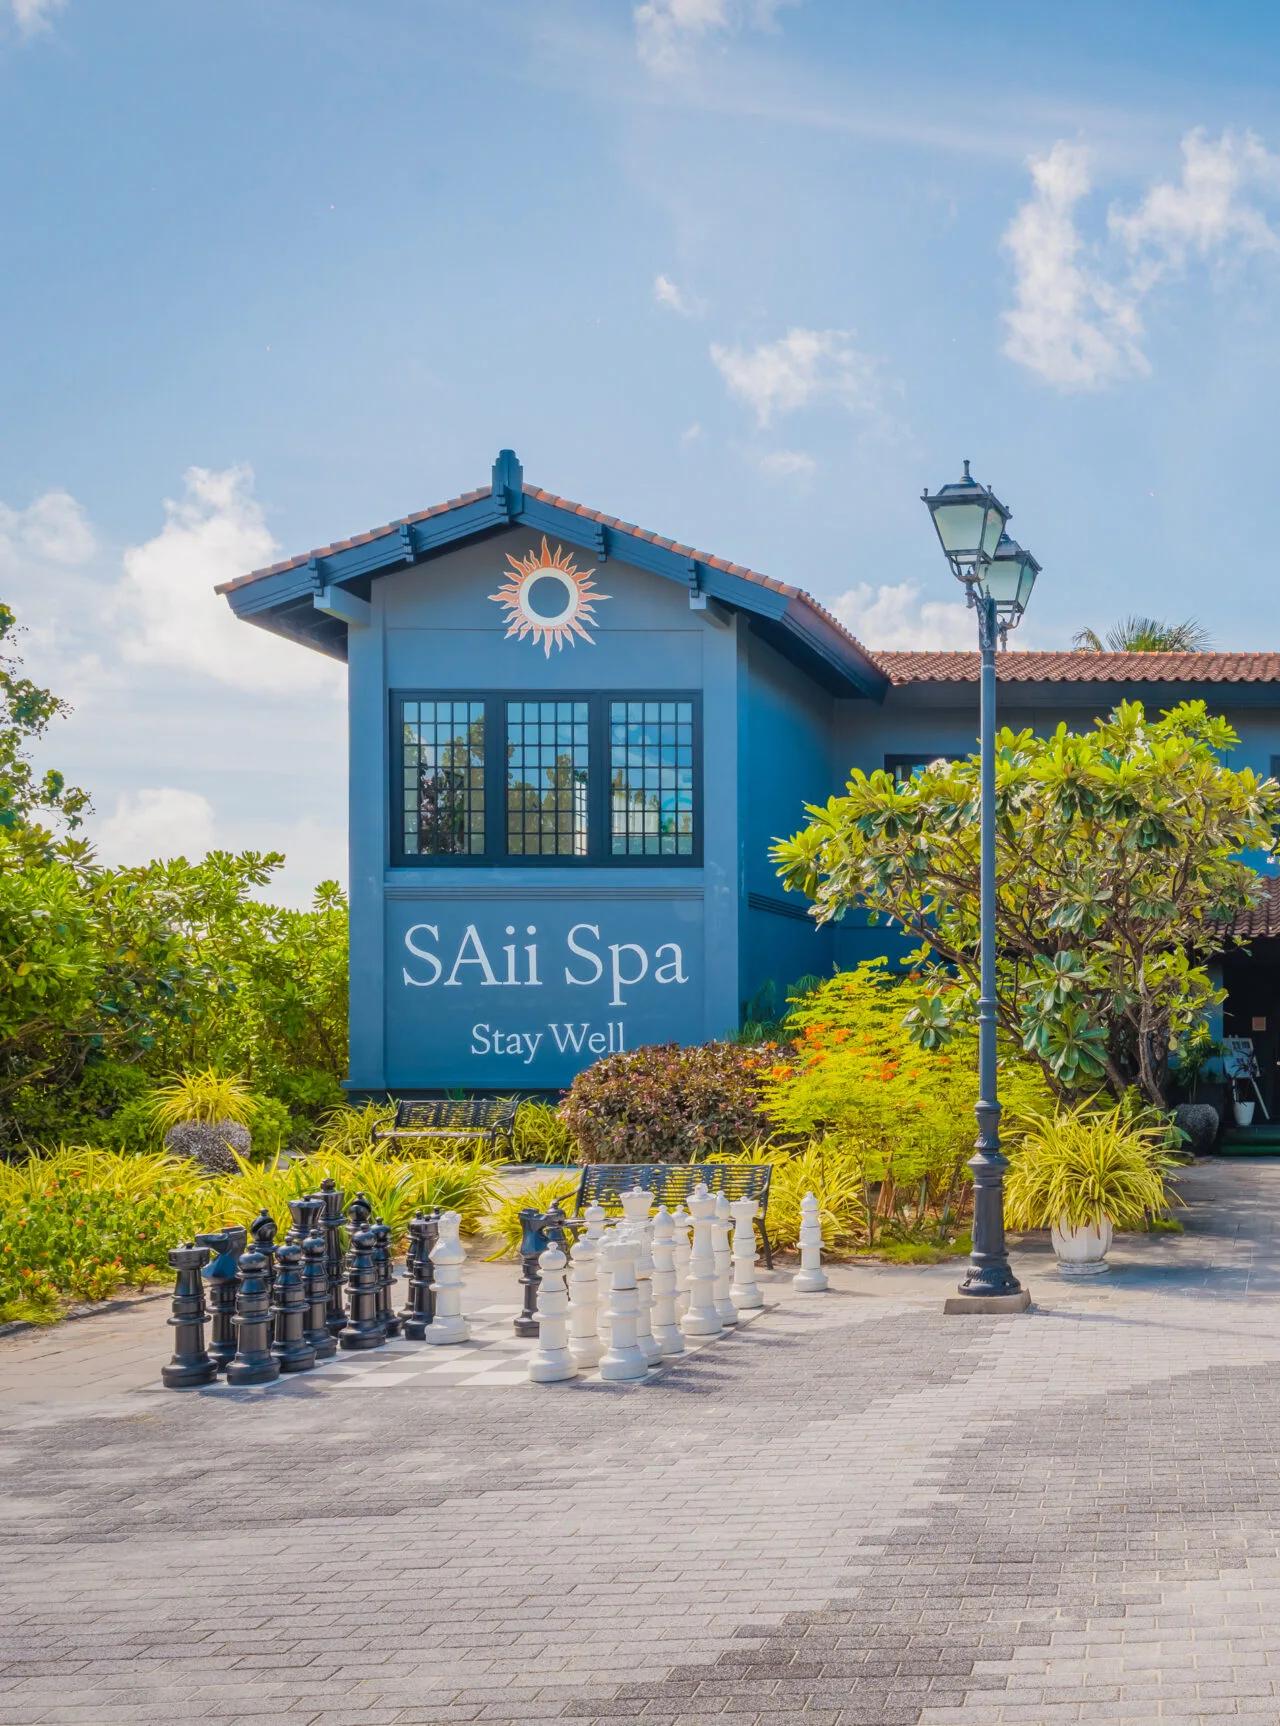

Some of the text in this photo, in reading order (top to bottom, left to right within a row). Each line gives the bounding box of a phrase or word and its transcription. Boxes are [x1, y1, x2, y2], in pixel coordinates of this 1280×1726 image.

[402, 923, 689, 1006] SAii Spa
[471, 1021, 626, 1064] Stay Well
